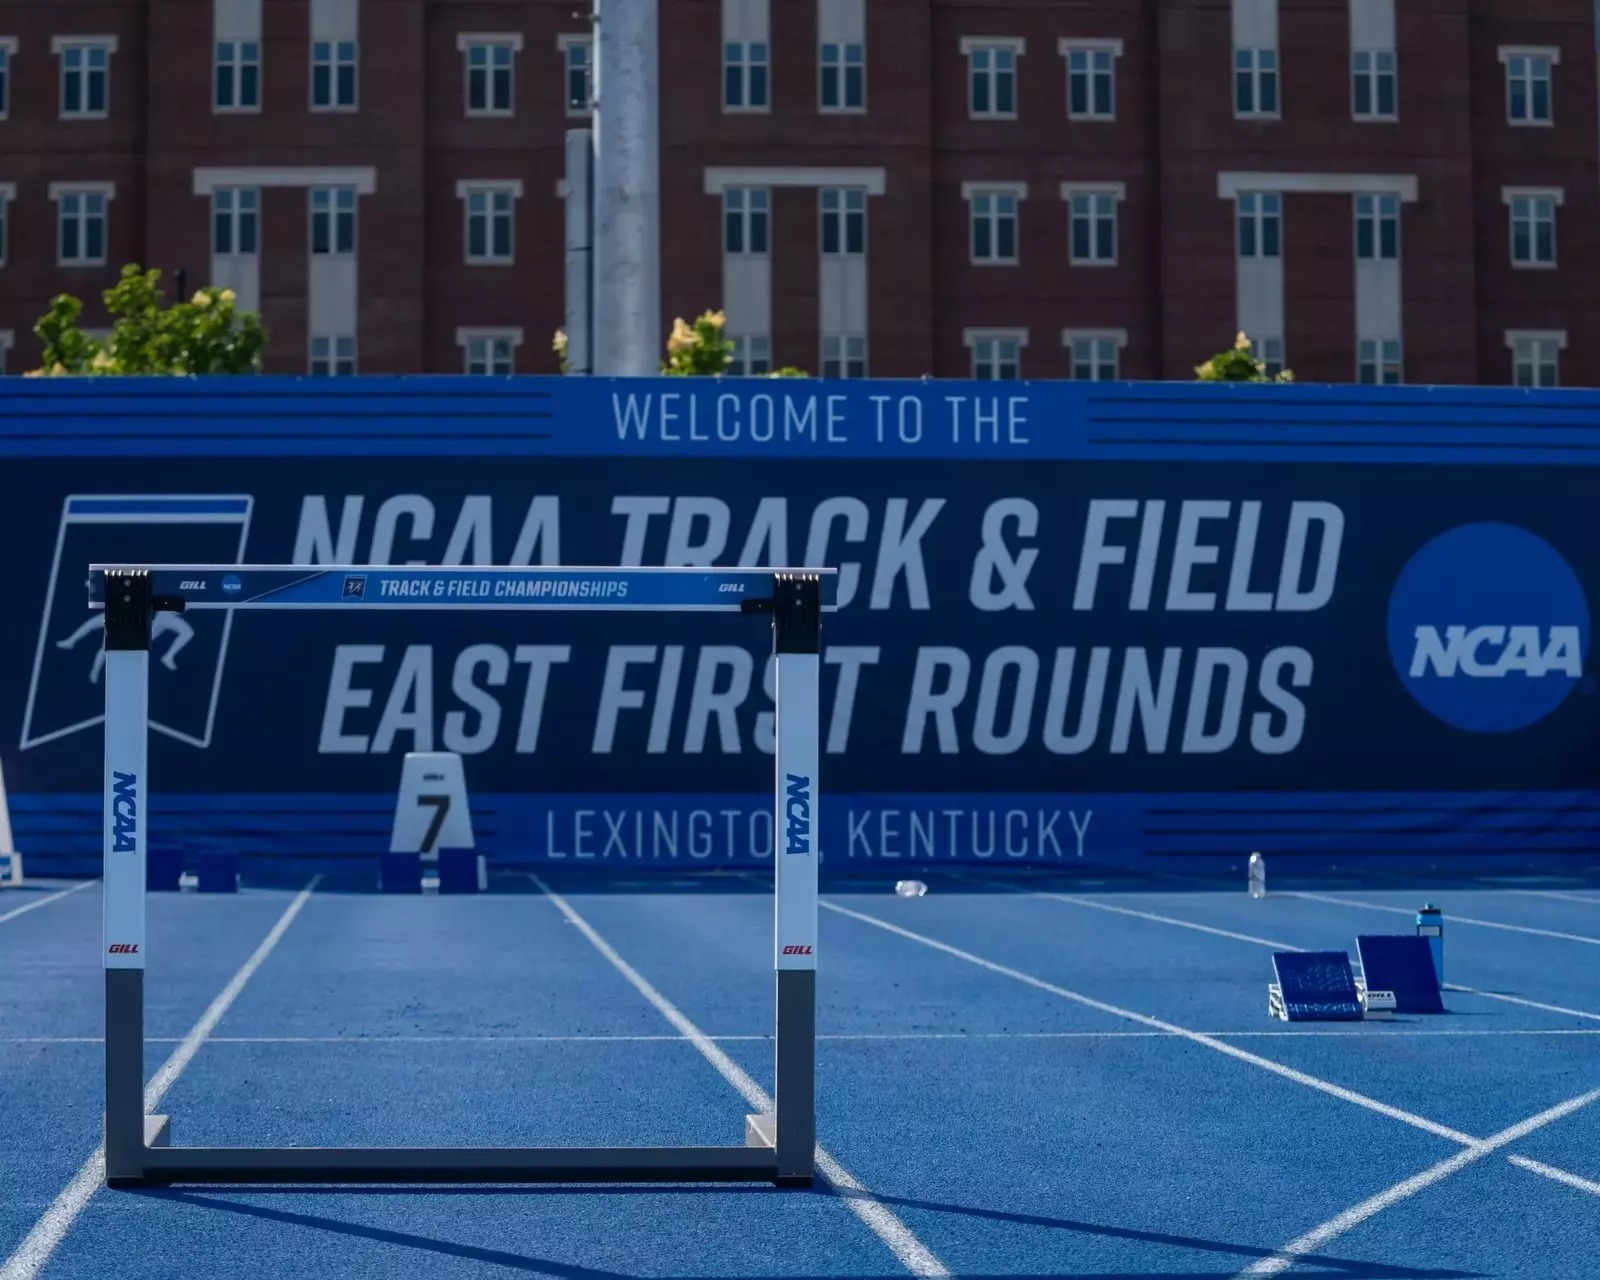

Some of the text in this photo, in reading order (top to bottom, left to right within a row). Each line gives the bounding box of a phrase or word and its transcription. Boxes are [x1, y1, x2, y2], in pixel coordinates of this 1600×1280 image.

[612, 392, 1029, 444] WELCOME TO THE
[292, 494, 1345, 611] NCAA TRACK & FIELD
[179, 580, 207, 590] GILL
[379, 579, 628, 598] TRACK & FIELD CHAMPIONSHIPS
[718, 583, 745, 592] GILL
[1409, 625, 1582, 678] NCAA
[318, 643, 570, 754] EAST
[901, 645, 1314, 755] ROUNDS
[112, 770, 137, 853] NCAA
[416, 794, 451, 853] 7
[547, 809, 1094, 865] LEXINGTO, KENTUCKY
[786, 773, 810, 856] NCAA
[108, 944, 139, 954] GILL
[782, 945, 812, 955] GILL
